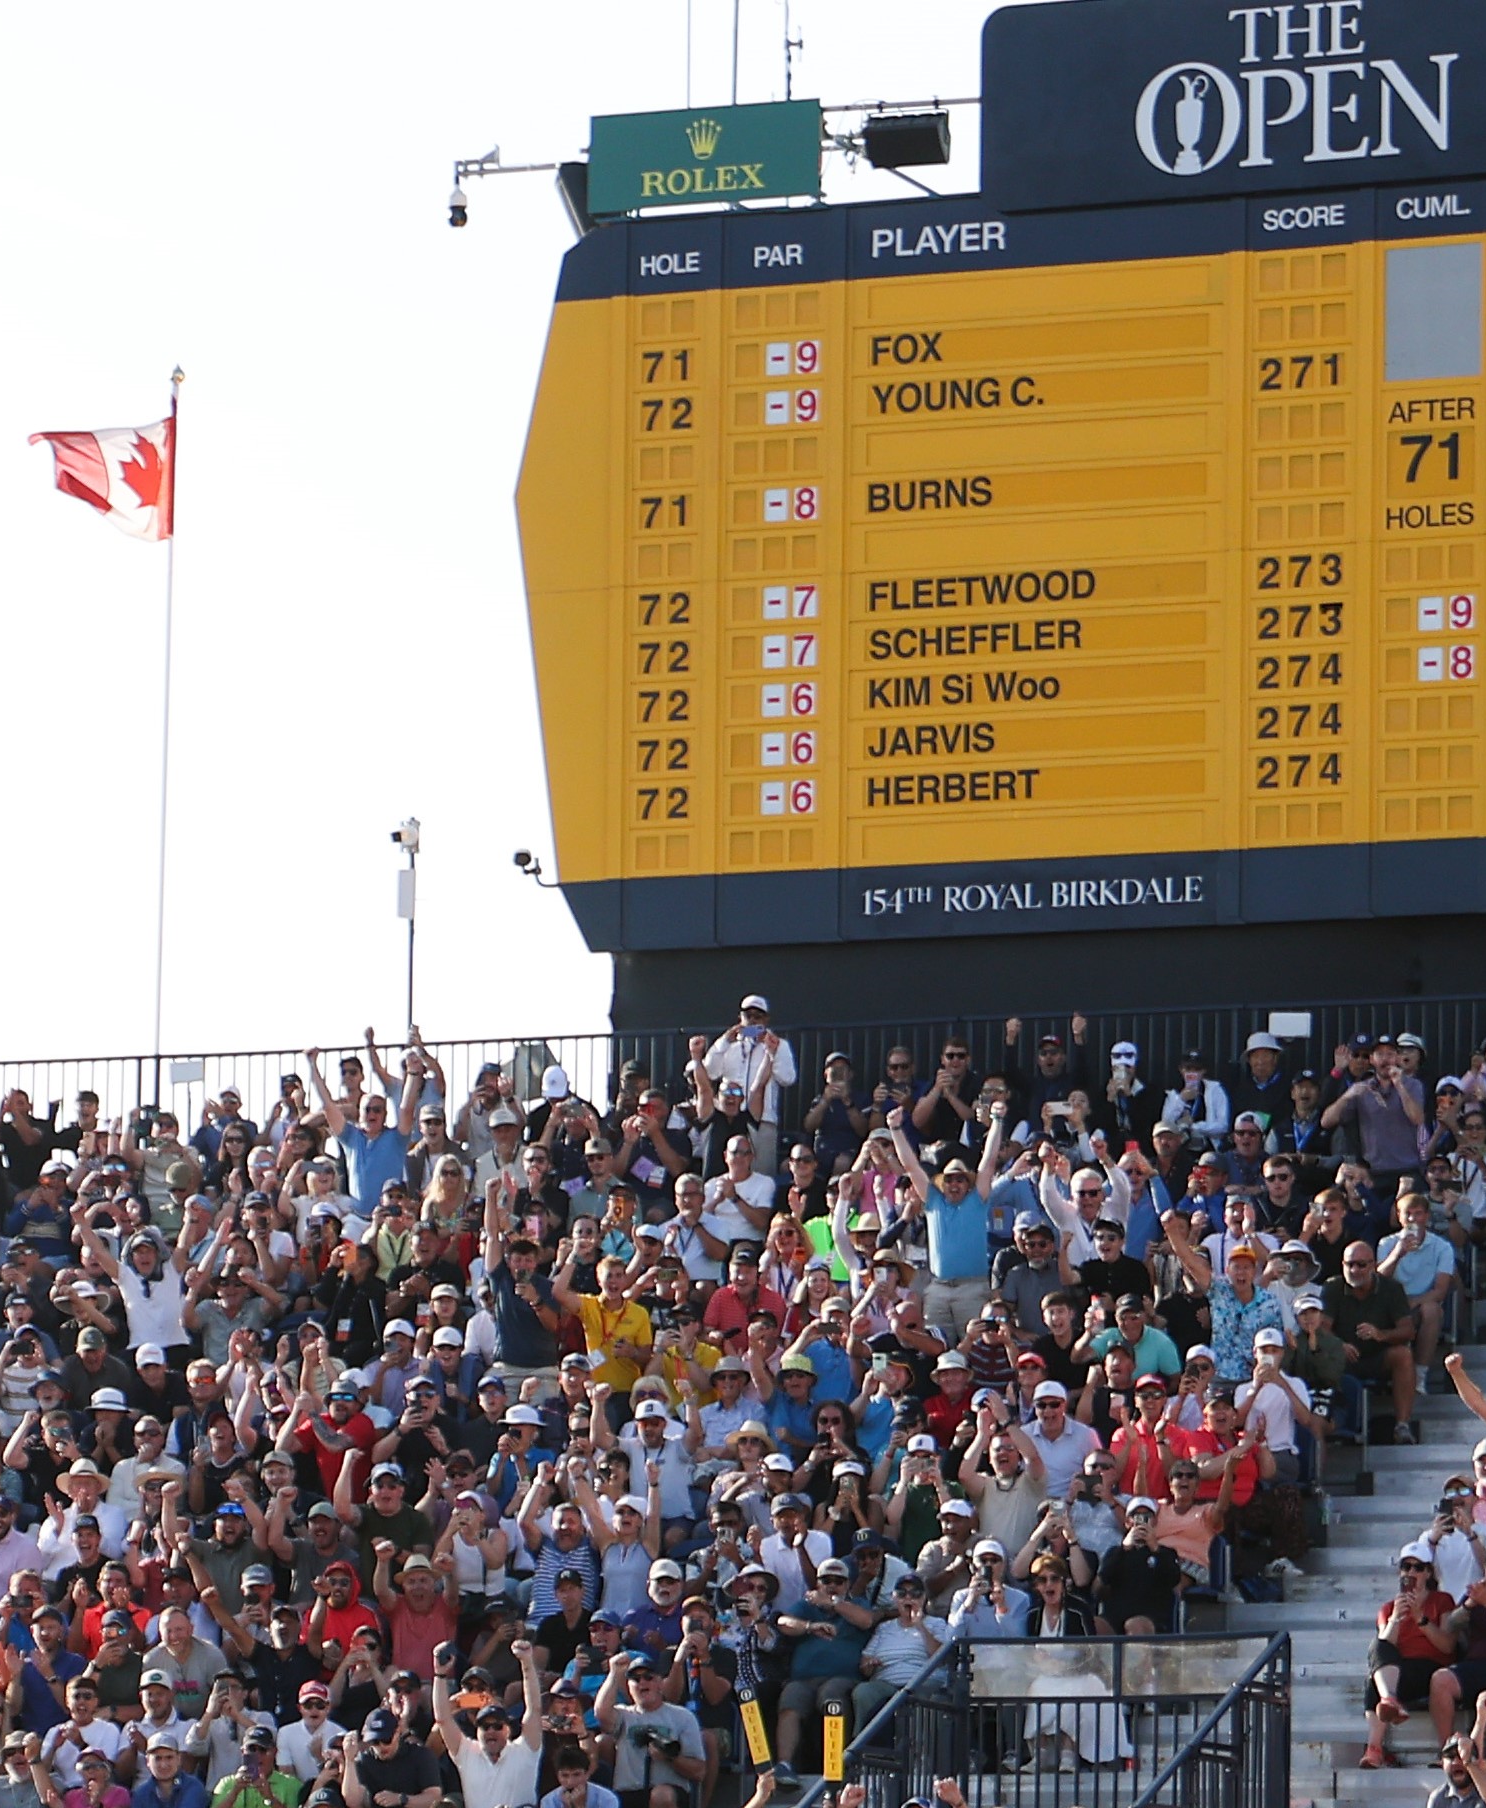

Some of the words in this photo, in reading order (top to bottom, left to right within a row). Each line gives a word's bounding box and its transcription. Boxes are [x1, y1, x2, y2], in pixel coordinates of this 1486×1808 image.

[1229, 0, 1365, 64] THE
[1135, 53, 1459, 175] OPEN
[641, 163, 765, 197] ROLEX
[1262, 204, 1345, 232] SCORE
[1396, 195, 1471, 220] CUML.
[753, 244, 803, 268] PAR
[871, 221, 1006, 258] PLAYER
[640, 251, 700, 276] HOLE
[642, 350, 690, 384] 71
[871, 332, 942, 367] FOX
[1259, 354, 1339, 391] 271
[874, 378, 1000, 414] YOUNG
[1011, 376, 1044, 407] C.
[1388, 397, 1475, 424] AFTER
[643, 397, 692, 432] 72
[1399, 432, 1459, 484] 71
[641, 495, 687, 529] 71
[868, 476, 992, 514] BURNS
[1386, 502, 1474, 530] HOLES
[1258, 553, 1342, 590] 273
[869, 568, 1095, 612] FLEETWOOD
[639, 592, 690, 627] 72
[1258, 602, 1342, 640] 273
[639, 641, 689, 675] 72
[869, 620, 1081, 660] SCHEFFLER
[1257, 652, 1341, 690] 274
[638, 690, 689, 724] 72
[868, 676, 931, 709] KIM
[942, 673, 973, 704] Si
[984, 671, 1060, 702] Woo
[1257, 703, 1341, 740] 274
[638, 738, 688, 773] 72
[868, 723, 995, 758] JARVIS
[867, 769, 1040, 808] HERBERT
[1257, 753, 1341, 790] 274
[637, 787, 688, 821] 72
[862, 886, 932, 915] 154TH
[943, 883, 1041, 913] ROYAL
[1051, 876, 1203, 909] BIRKDALE
